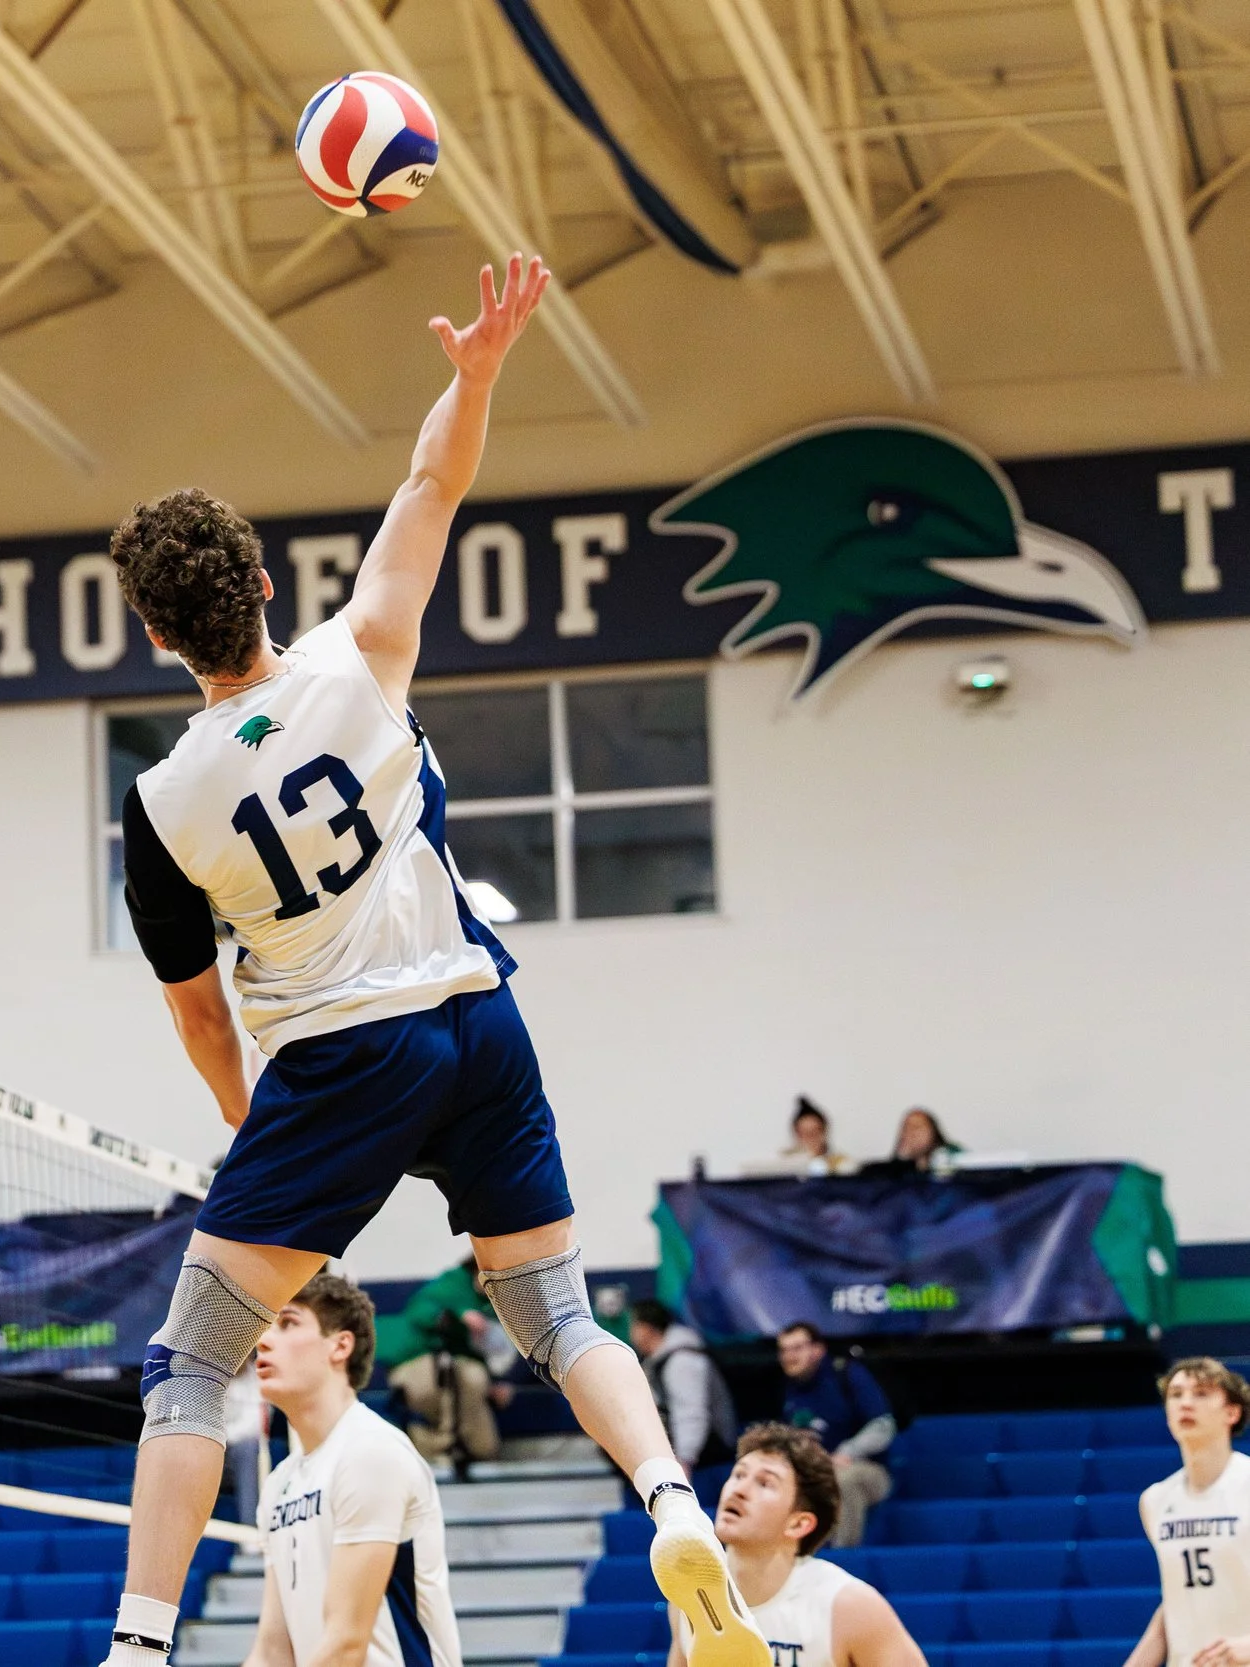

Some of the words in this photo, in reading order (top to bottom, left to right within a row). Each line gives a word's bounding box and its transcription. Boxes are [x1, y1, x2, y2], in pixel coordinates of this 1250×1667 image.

[457, 512, 628, 645] OF
[231, 753, 383, 921] 13
[1181, 1547, 1216, 1588] 15
